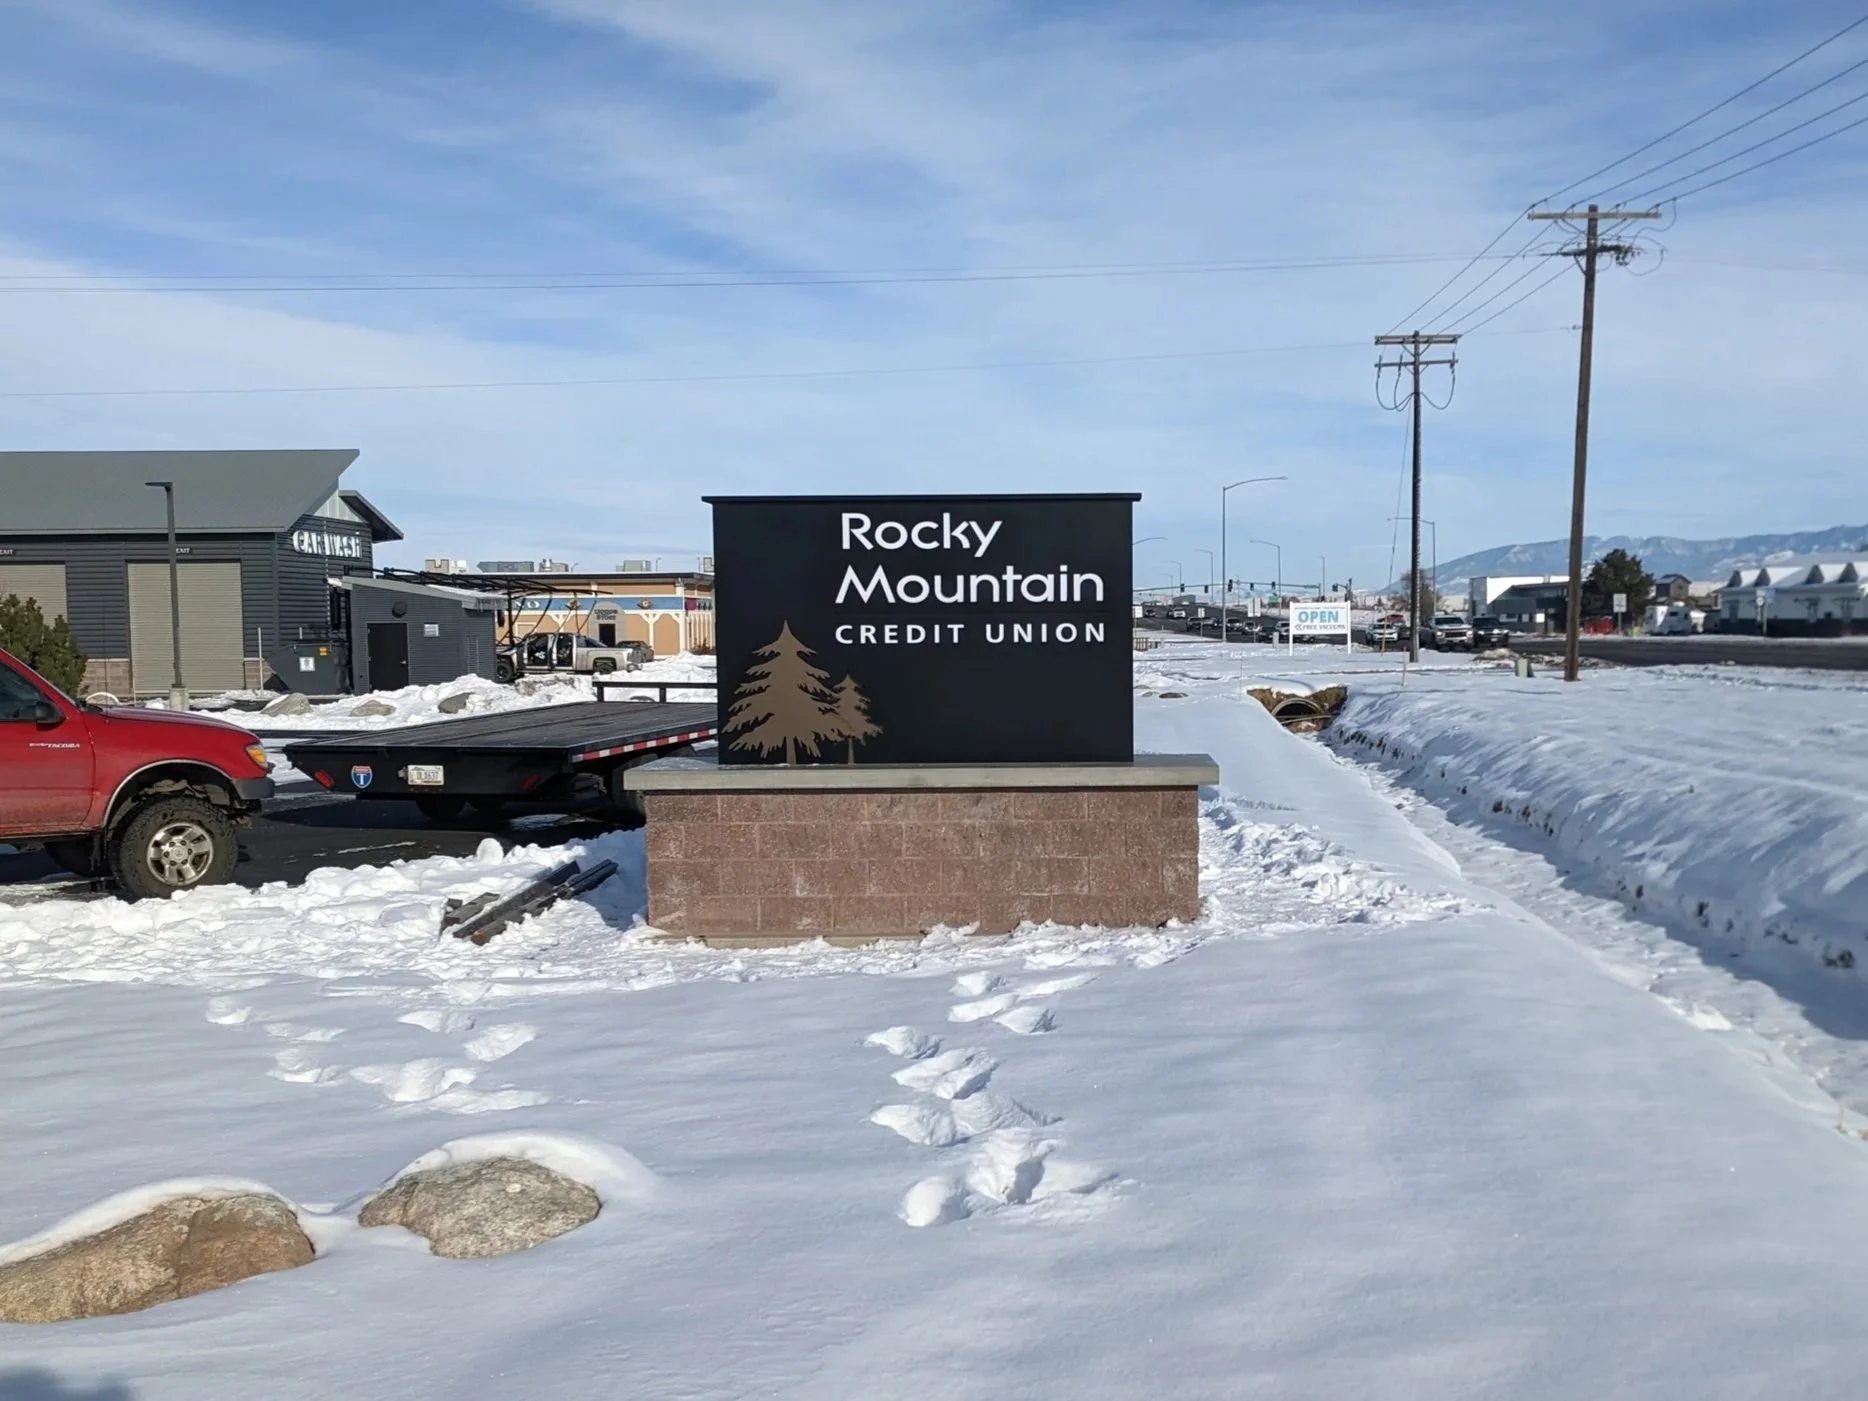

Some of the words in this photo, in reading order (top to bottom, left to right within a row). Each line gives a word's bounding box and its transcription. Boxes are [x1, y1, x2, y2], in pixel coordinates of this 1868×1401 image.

[292, 530, 322, 555] CAR
[323, 533, 362, 559] WASH
[841, 512, 1003, 558] Rocky
[834, 564, 1104, 604] Mountain
[1298, 610, 1340, 623] OPEN
[834, 623, 965, 645] CREDIT
[985, 622, 1105, 643] UNION
